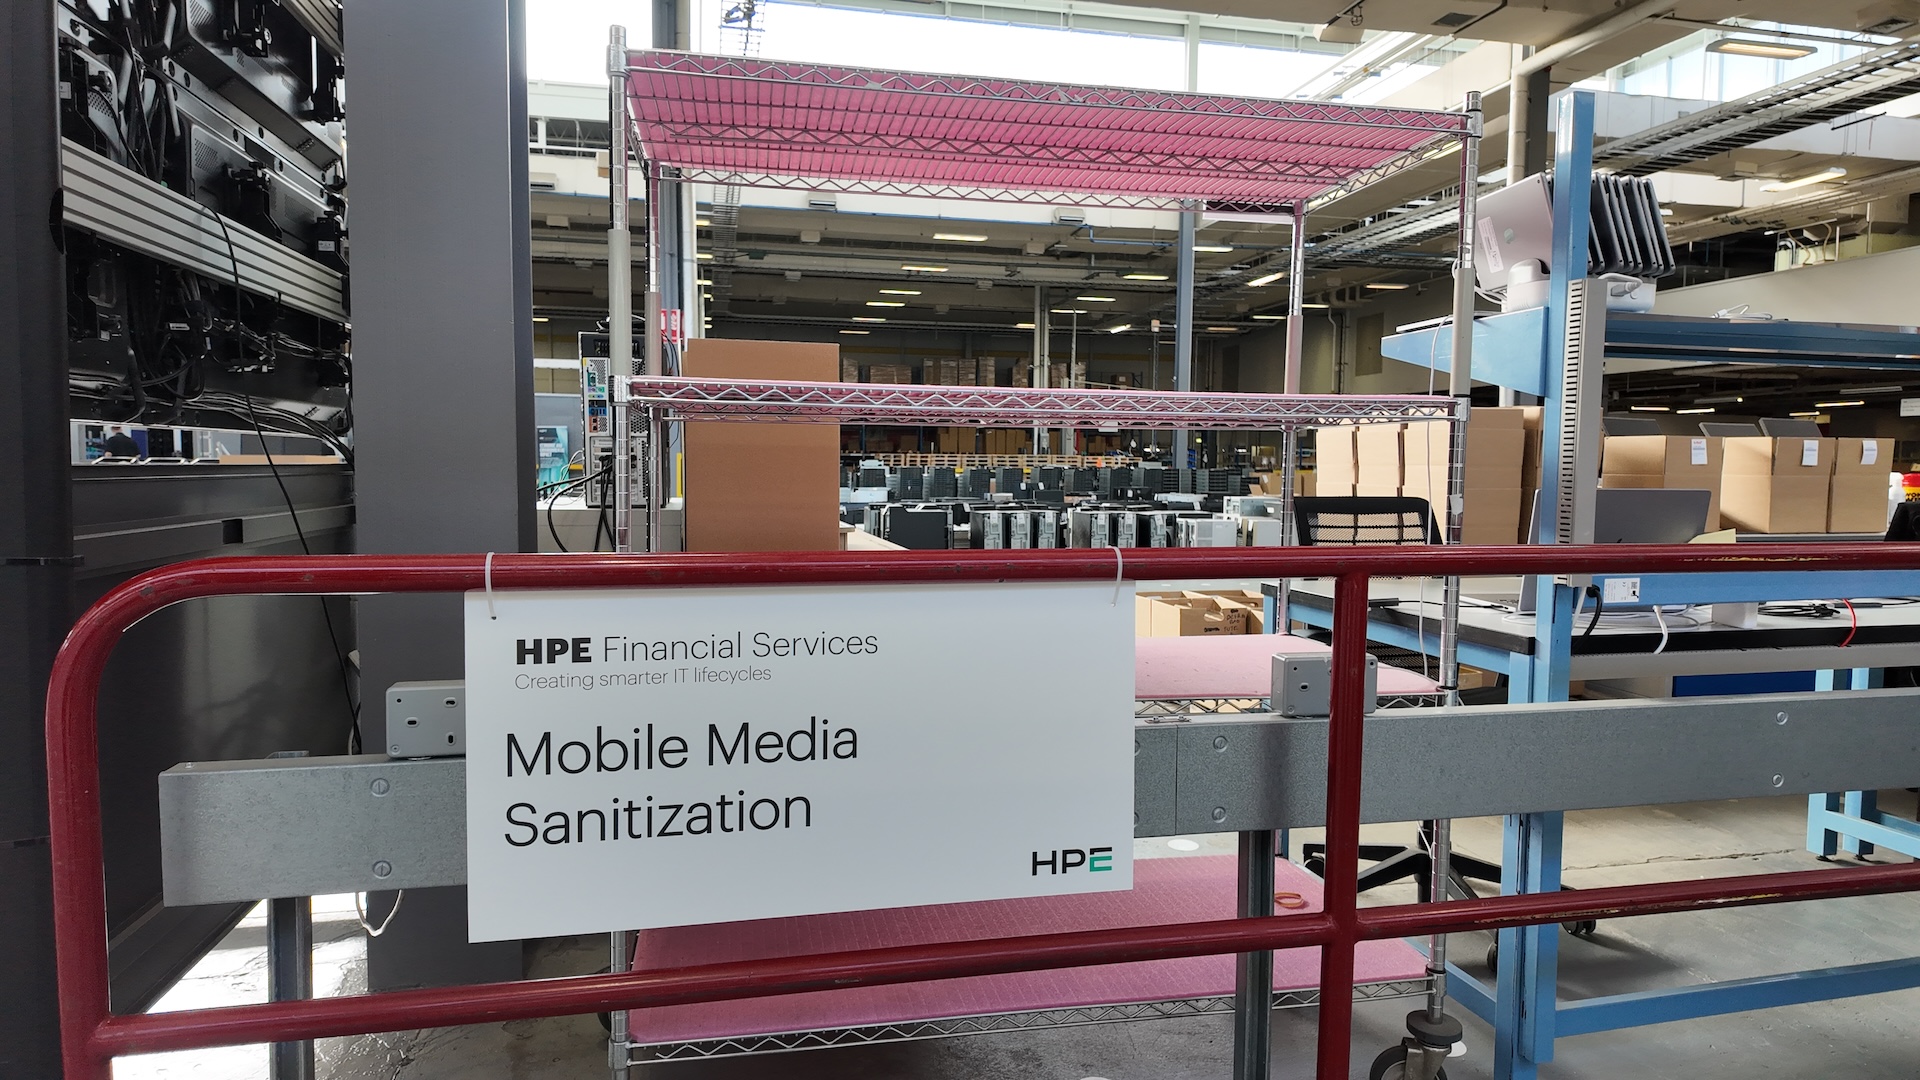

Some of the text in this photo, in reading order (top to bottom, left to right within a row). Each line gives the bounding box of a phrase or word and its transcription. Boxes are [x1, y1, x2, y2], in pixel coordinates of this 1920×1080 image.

[515, 630, 879, 666] HPE Financial Services
[514, 664, 772, 691] Creating smarter IT lifecycles
[506, 715, 859, 778] Mobile Media
[504, 789, 812, 848] Sanitization
[1031, 846, 1114, 877] HPE
